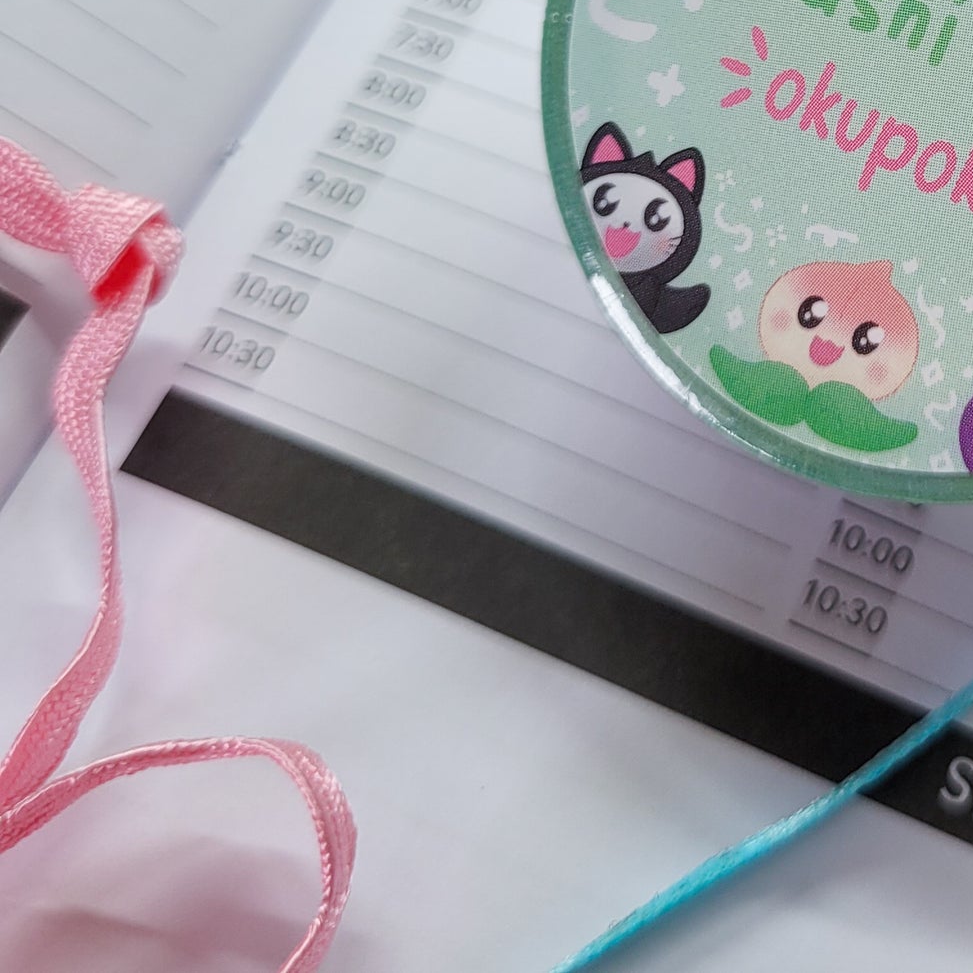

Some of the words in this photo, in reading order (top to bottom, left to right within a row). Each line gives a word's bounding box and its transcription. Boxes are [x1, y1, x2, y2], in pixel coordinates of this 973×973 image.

[394, 25, 455, 63] 7:30
[363, 70, 427, 111] 8:00
[333, 118, 397, 161] 8:30
[304, 169, 366, 211] 9:00
[272, 220, 335, 264] 9:30
[235, 271, 311, 319] 10:00
[201, 325, 276, 372] 10:30
[828, 518, 915, 573] 10:00
[802, 578, 889, 635] 10:30
